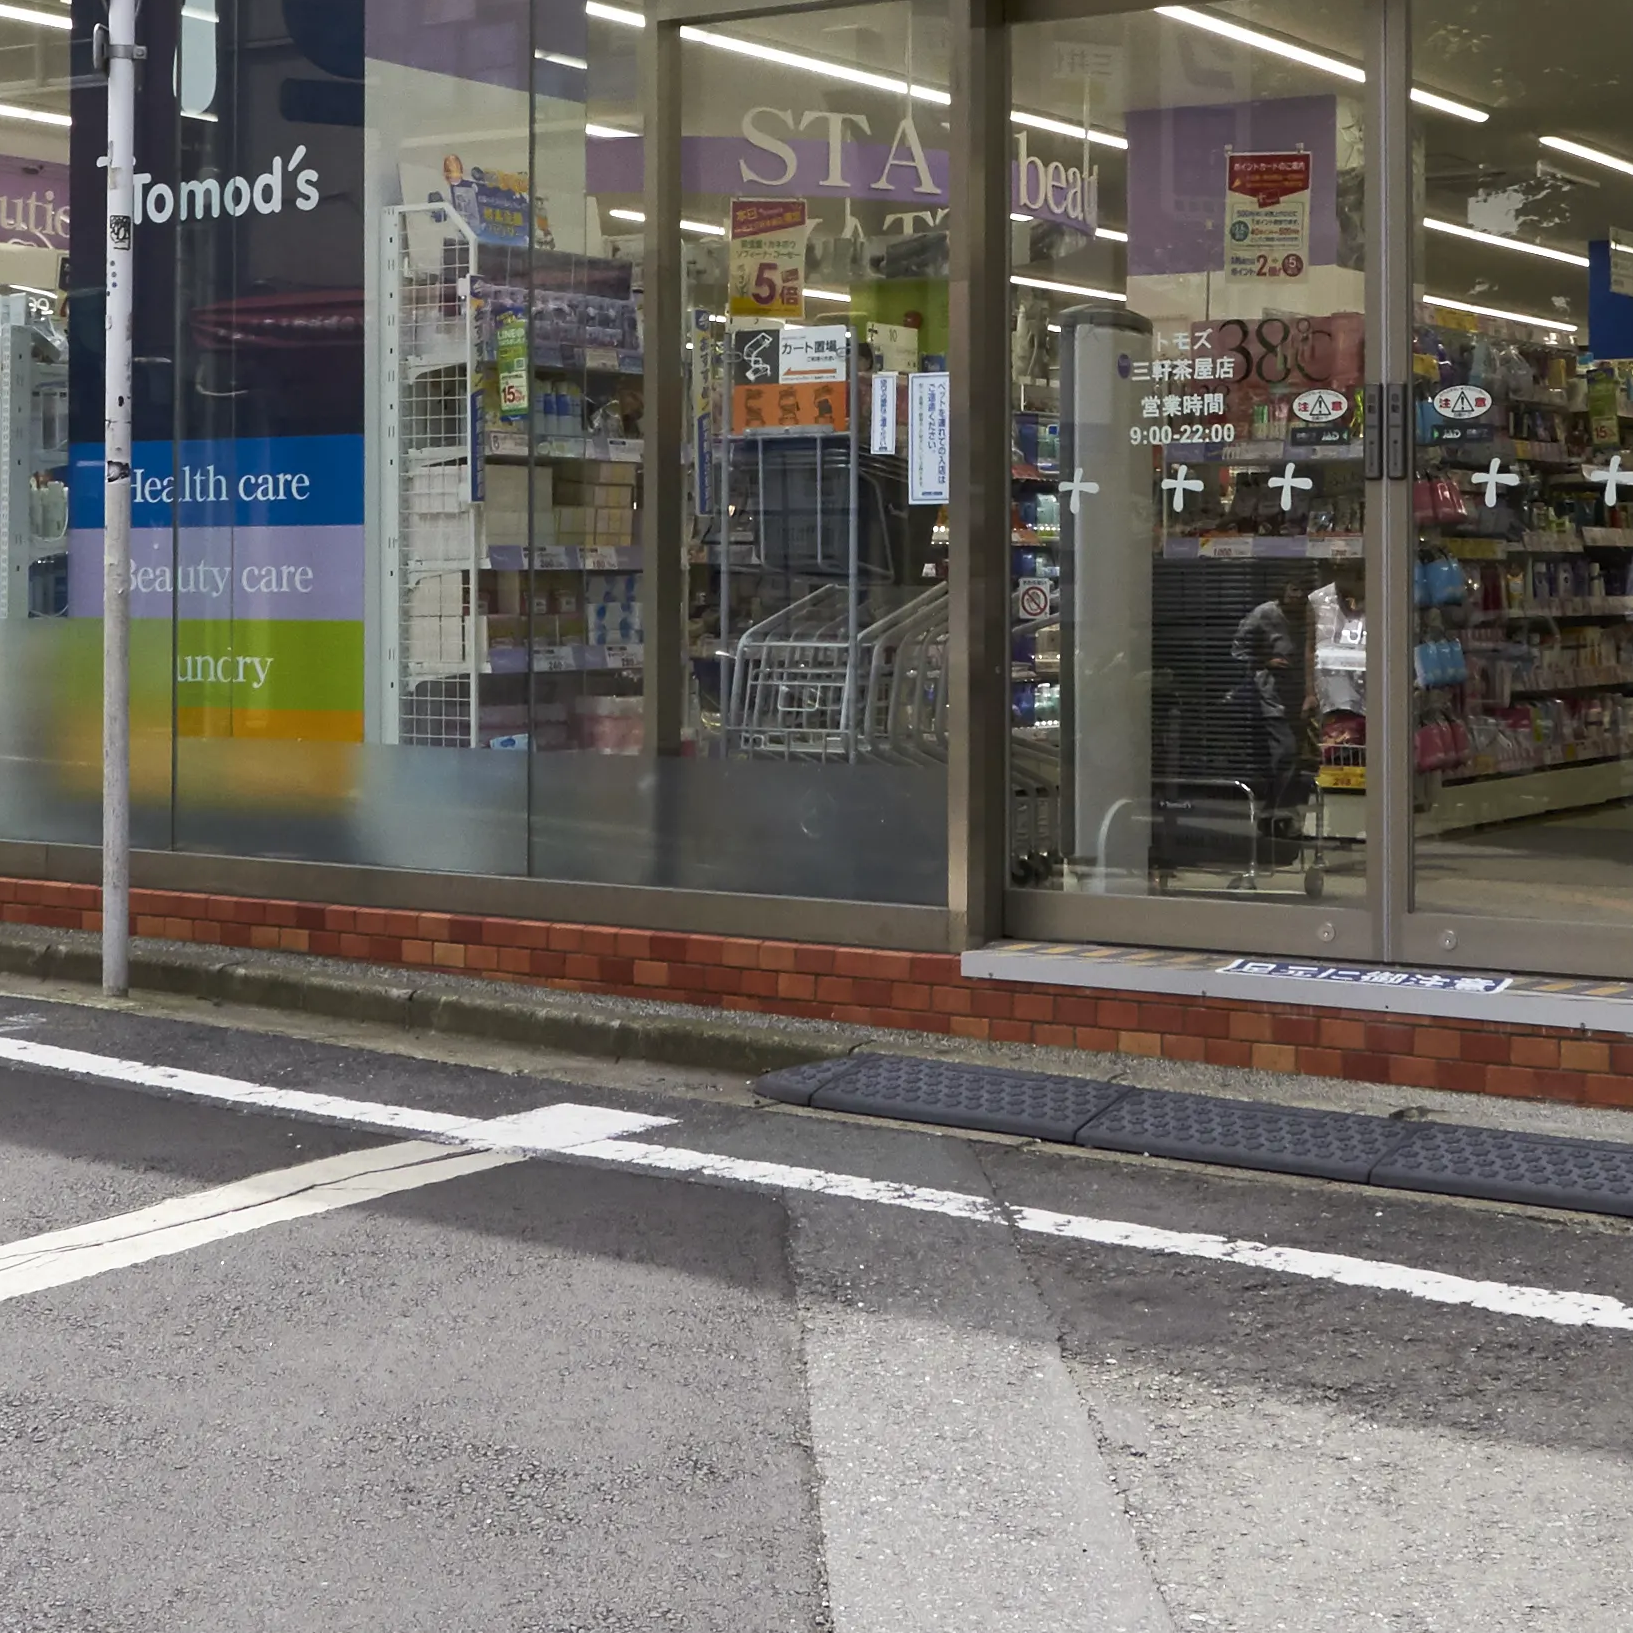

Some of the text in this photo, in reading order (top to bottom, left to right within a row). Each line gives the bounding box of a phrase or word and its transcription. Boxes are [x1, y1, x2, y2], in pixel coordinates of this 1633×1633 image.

[739, 107, 942, 195] STA
[131, 144, 320, 225] Tomod's
[782, 340, 837, 354] カート置場
[1155, 328, 1214, 351] トモズ
[1131, 356, 1235, 382] 三軒茶屋店
[1141, 393, 1224, 418] 営業時間
[1129, 423, 1235, 445] 9:00-22:00
[238, 469, 311, 502] care
[241, 562, 313, 593] care
